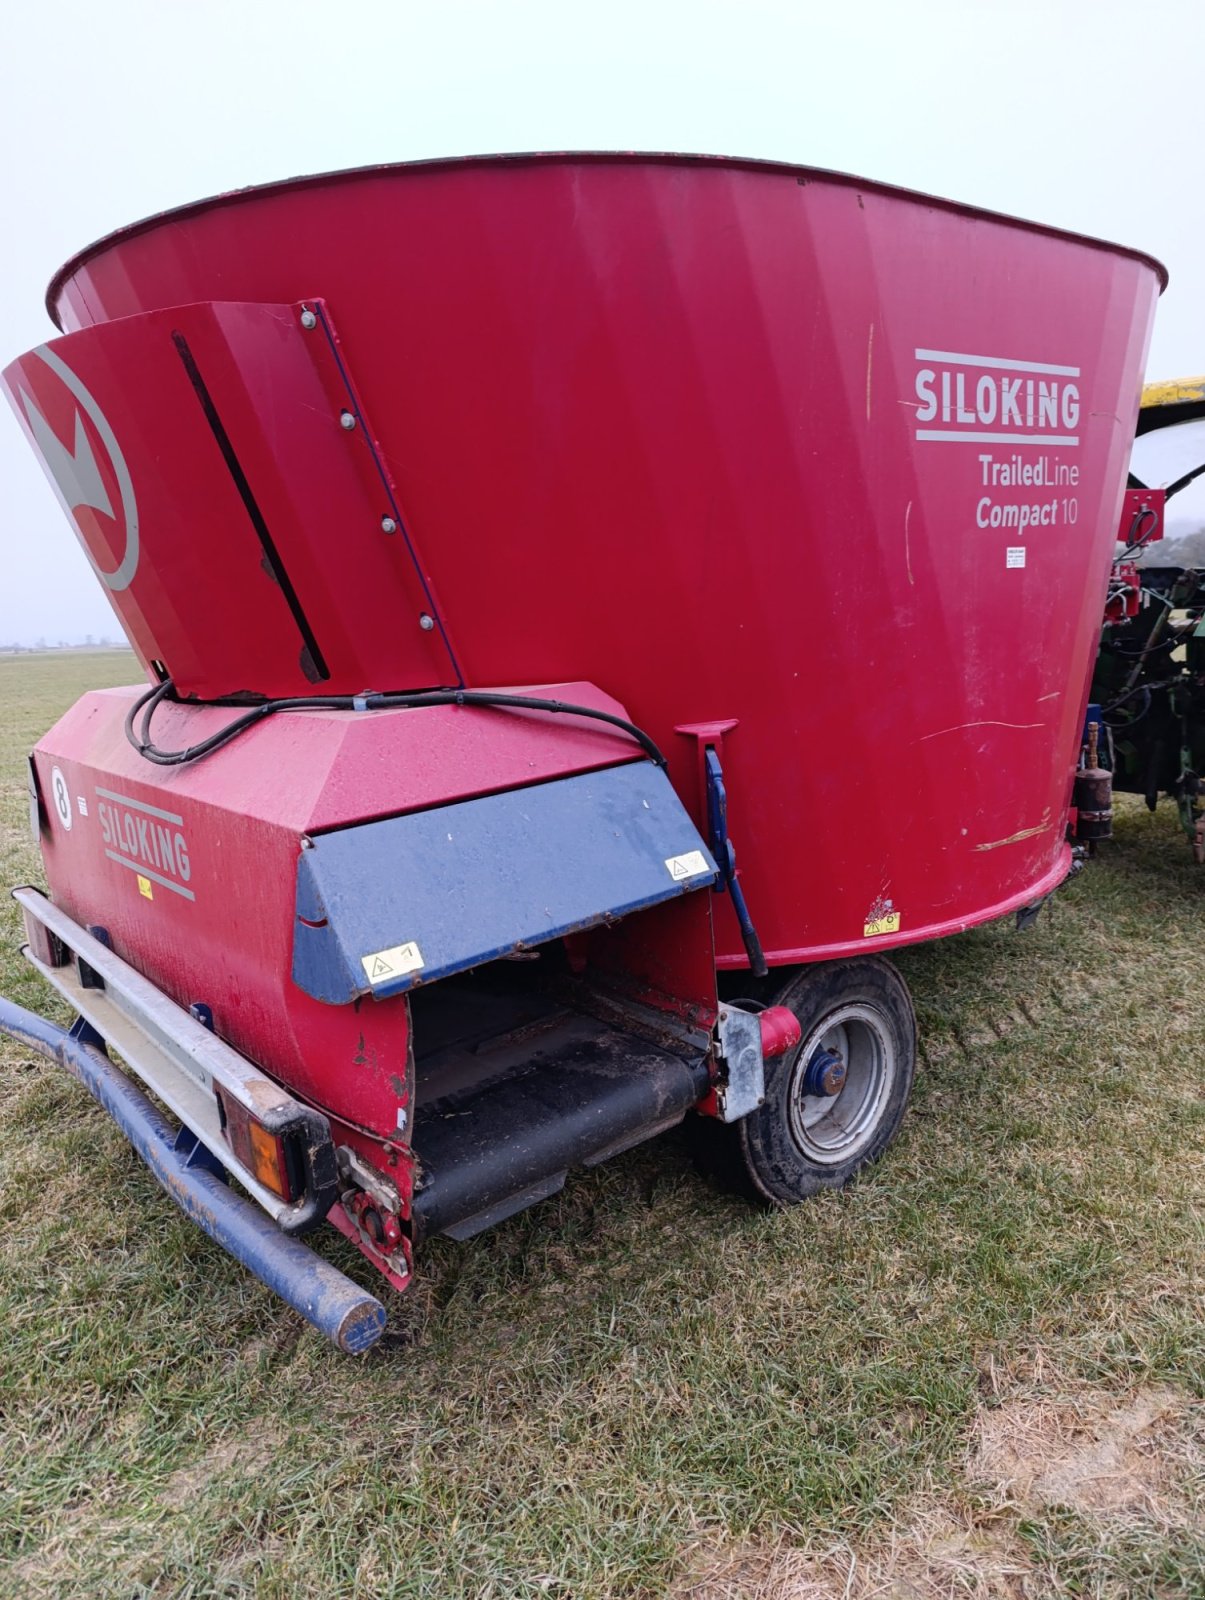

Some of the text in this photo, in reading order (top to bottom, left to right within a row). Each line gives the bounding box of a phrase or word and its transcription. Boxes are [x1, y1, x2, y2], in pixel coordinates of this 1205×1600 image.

[915, 369, 1080, 429] SILOKING
[979, 454, 1079, 486] TrailedLine
[976, 497, 1078, 535] Compact 10
[55, 777, 68, 819] 8
[98, 802, 191, 881] SILOKING
